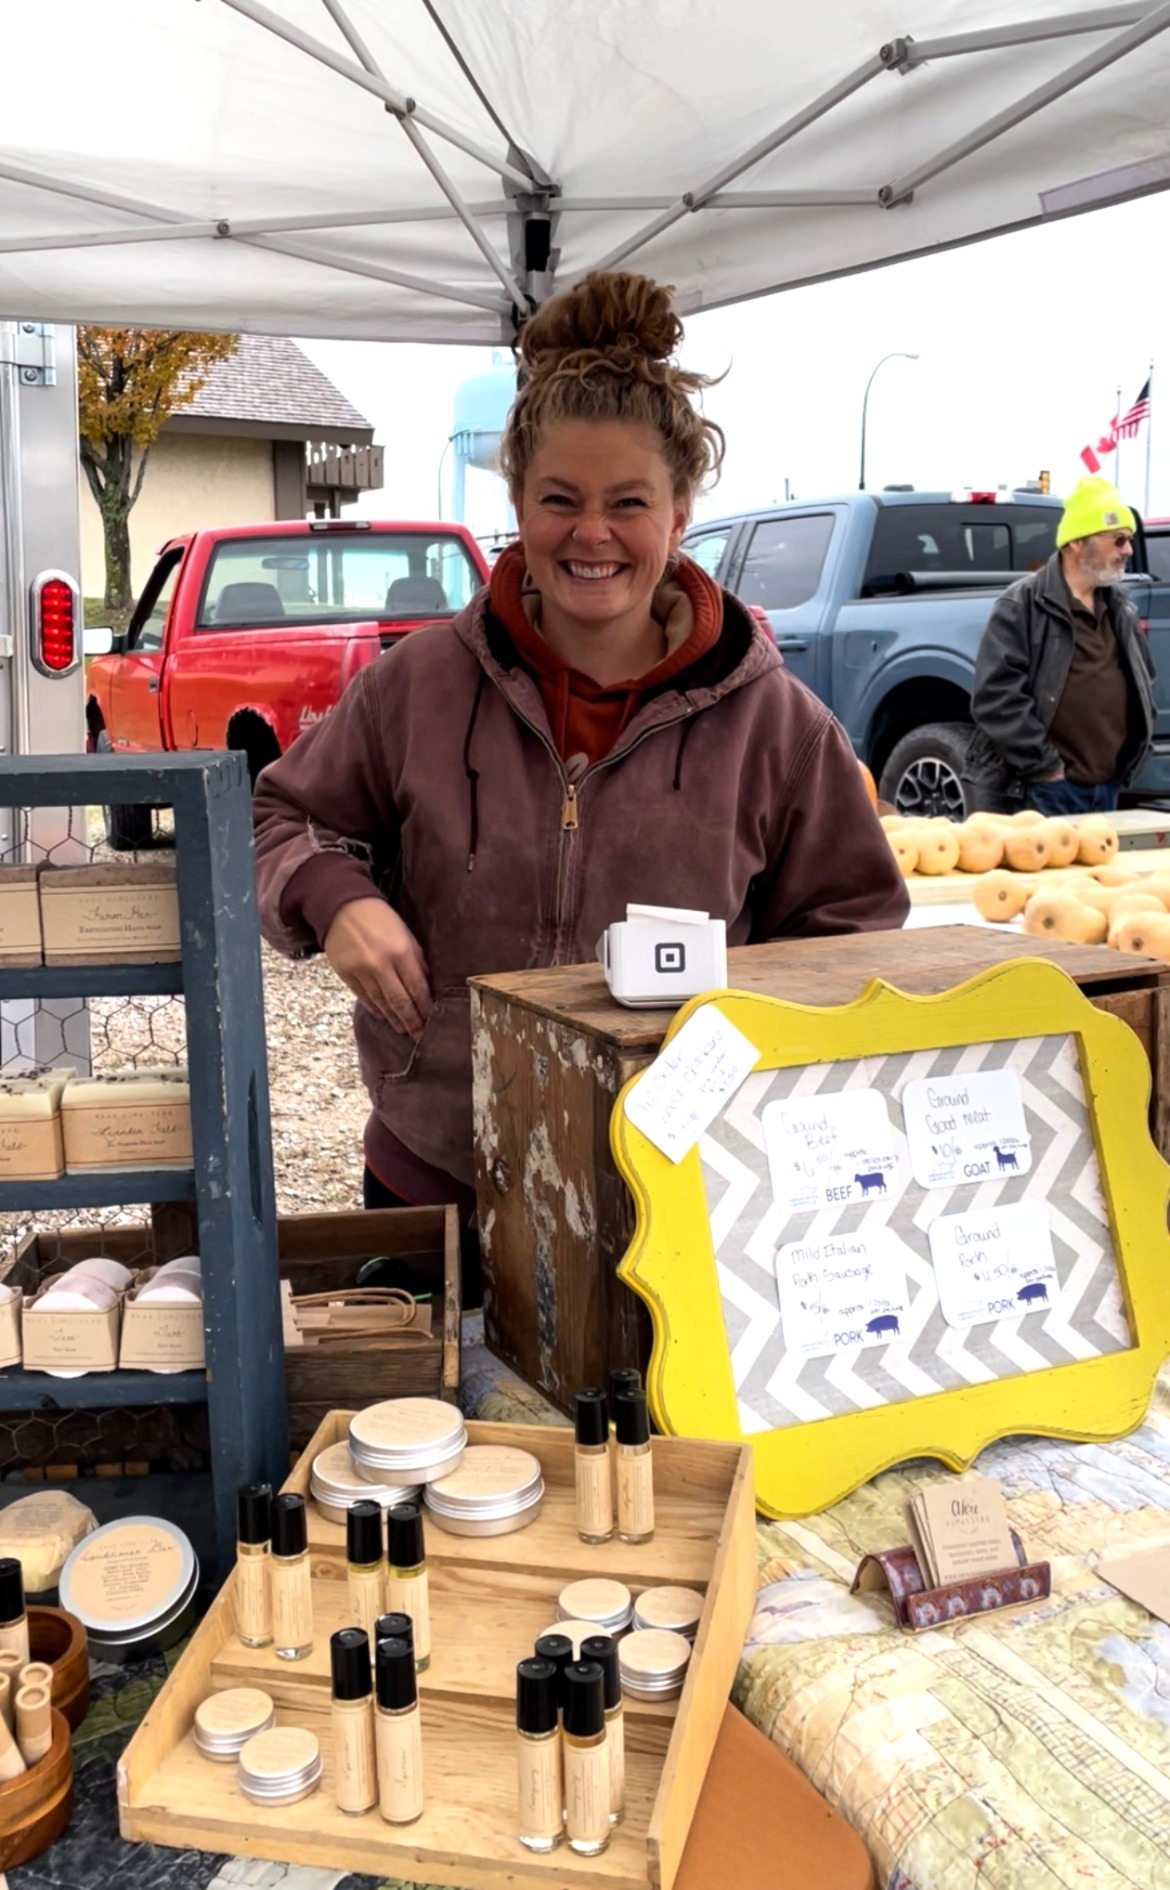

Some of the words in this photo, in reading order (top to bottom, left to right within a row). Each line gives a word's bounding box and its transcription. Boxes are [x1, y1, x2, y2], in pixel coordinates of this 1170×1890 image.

[926, 1087, 970, 1109] Ground
[963, 1161, 990, 1178] GOAT
[825, 1185, 852, 1202] BEEF
[954, 1221, 1001, 1246] Ground
[791, 1246, 821, 1264] Mild
[822, 1240, 867, 1258] Italian
[822, 1263, 873, 1282] Sausage
[987, 1297, 1016, 1315] PORK
[834, 1330, 864, 1346] PORK
